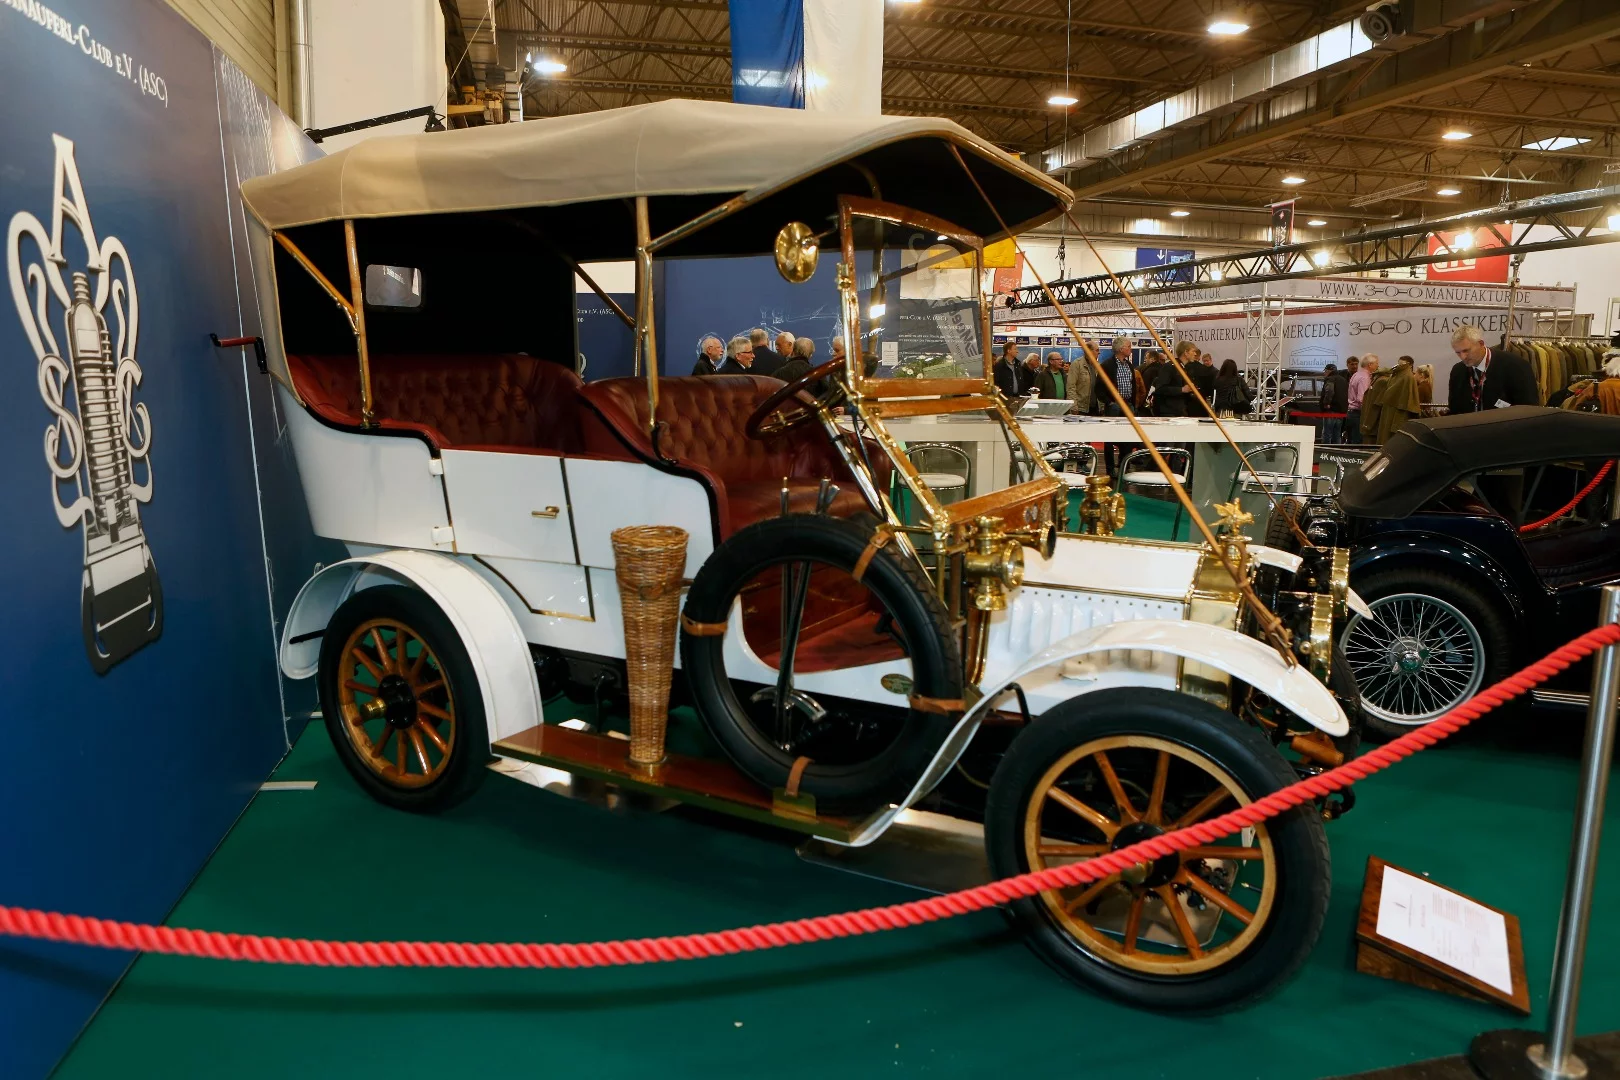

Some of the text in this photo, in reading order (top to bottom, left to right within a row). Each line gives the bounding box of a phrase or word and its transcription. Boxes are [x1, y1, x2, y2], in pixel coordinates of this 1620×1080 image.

[139, 64, 168, 108] (ASC)
[1178, 328, 1250, 342] RESTAURIERUN
[1282, 322, 1341, 339] MERCEDES
[1421, 313, 1524, 334] KLASSIKERN
